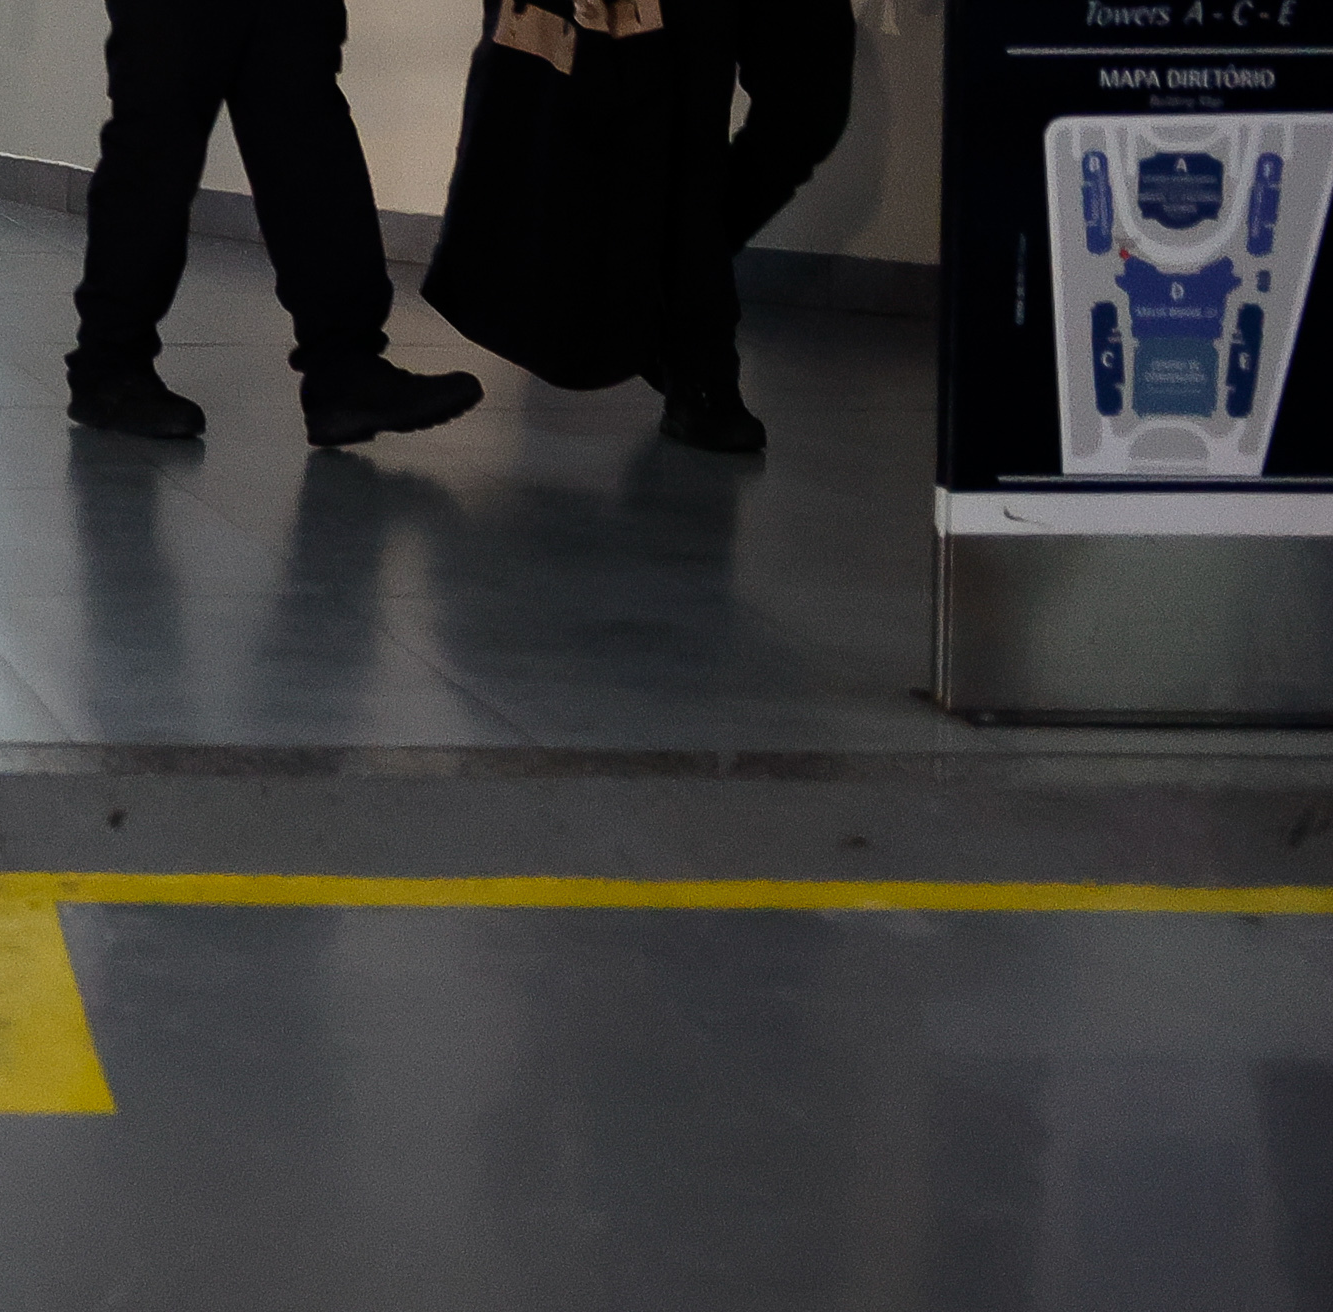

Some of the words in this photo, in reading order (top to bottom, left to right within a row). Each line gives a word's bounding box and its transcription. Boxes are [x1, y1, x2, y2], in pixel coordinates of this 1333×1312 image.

[1086, 0, 1171, 27] Towers
[1099, 68, 1161, 89] MAPA
[1175, 157, 1188, 173] A
[1100, 350, 1114, 368] C
